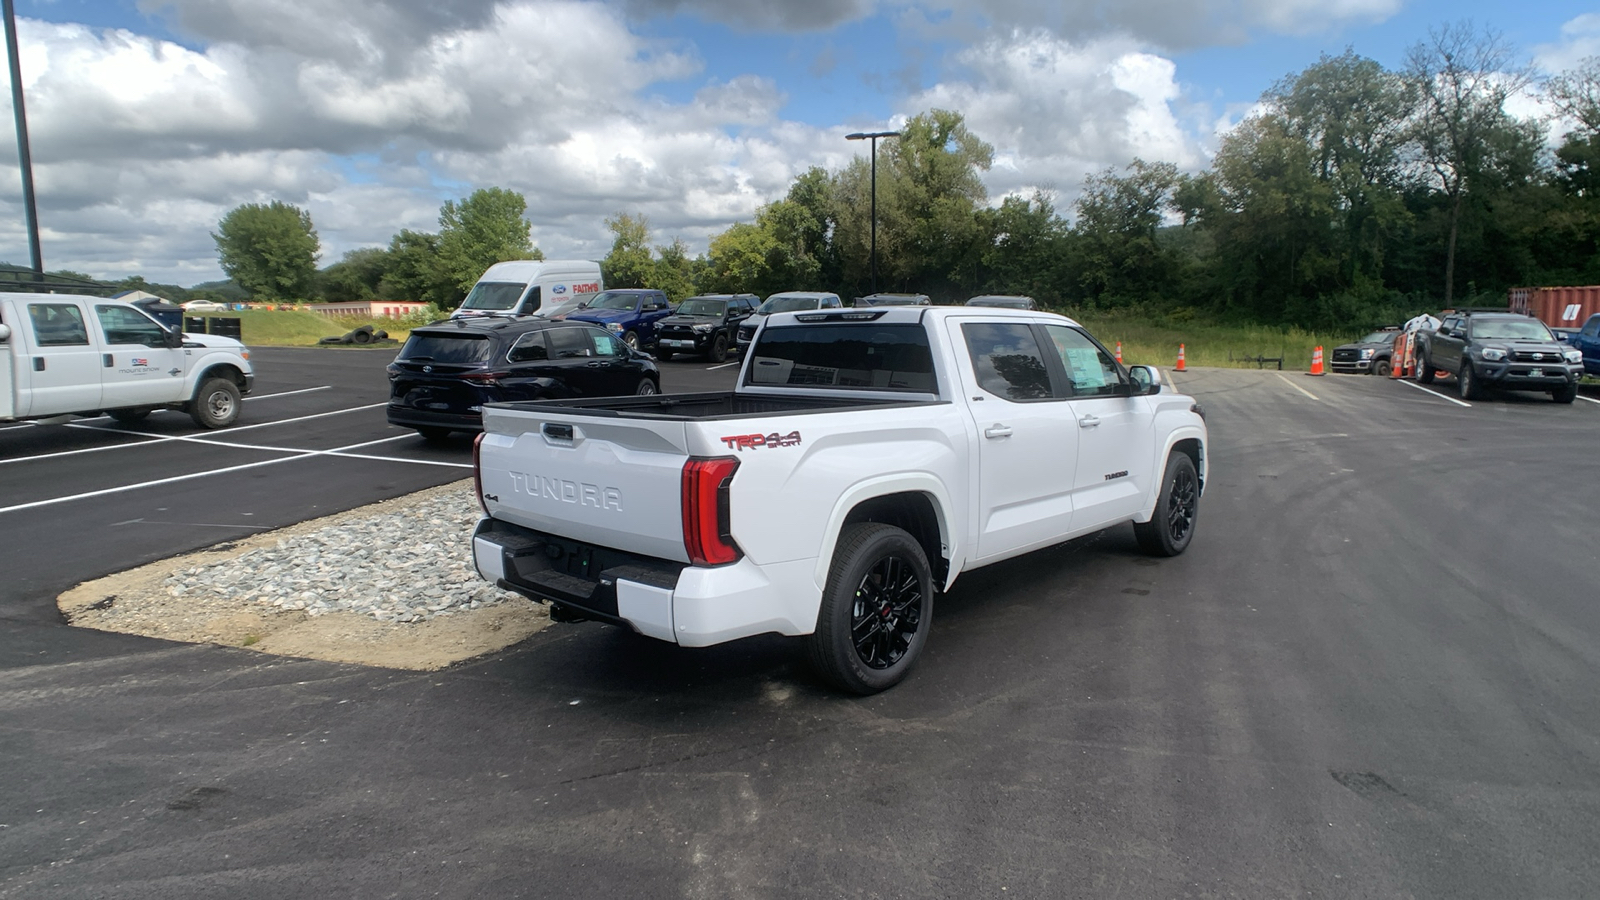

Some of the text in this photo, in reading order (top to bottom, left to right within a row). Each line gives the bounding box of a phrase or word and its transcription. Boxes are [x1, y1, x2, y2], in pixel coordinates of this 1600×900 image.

[572, 283, 599, 294] FAITH'S
[720, 433, 767, 451] TRD
[767, 440, 801, 448] SPORT
[508, 470, 623, 512] TUNDRA
